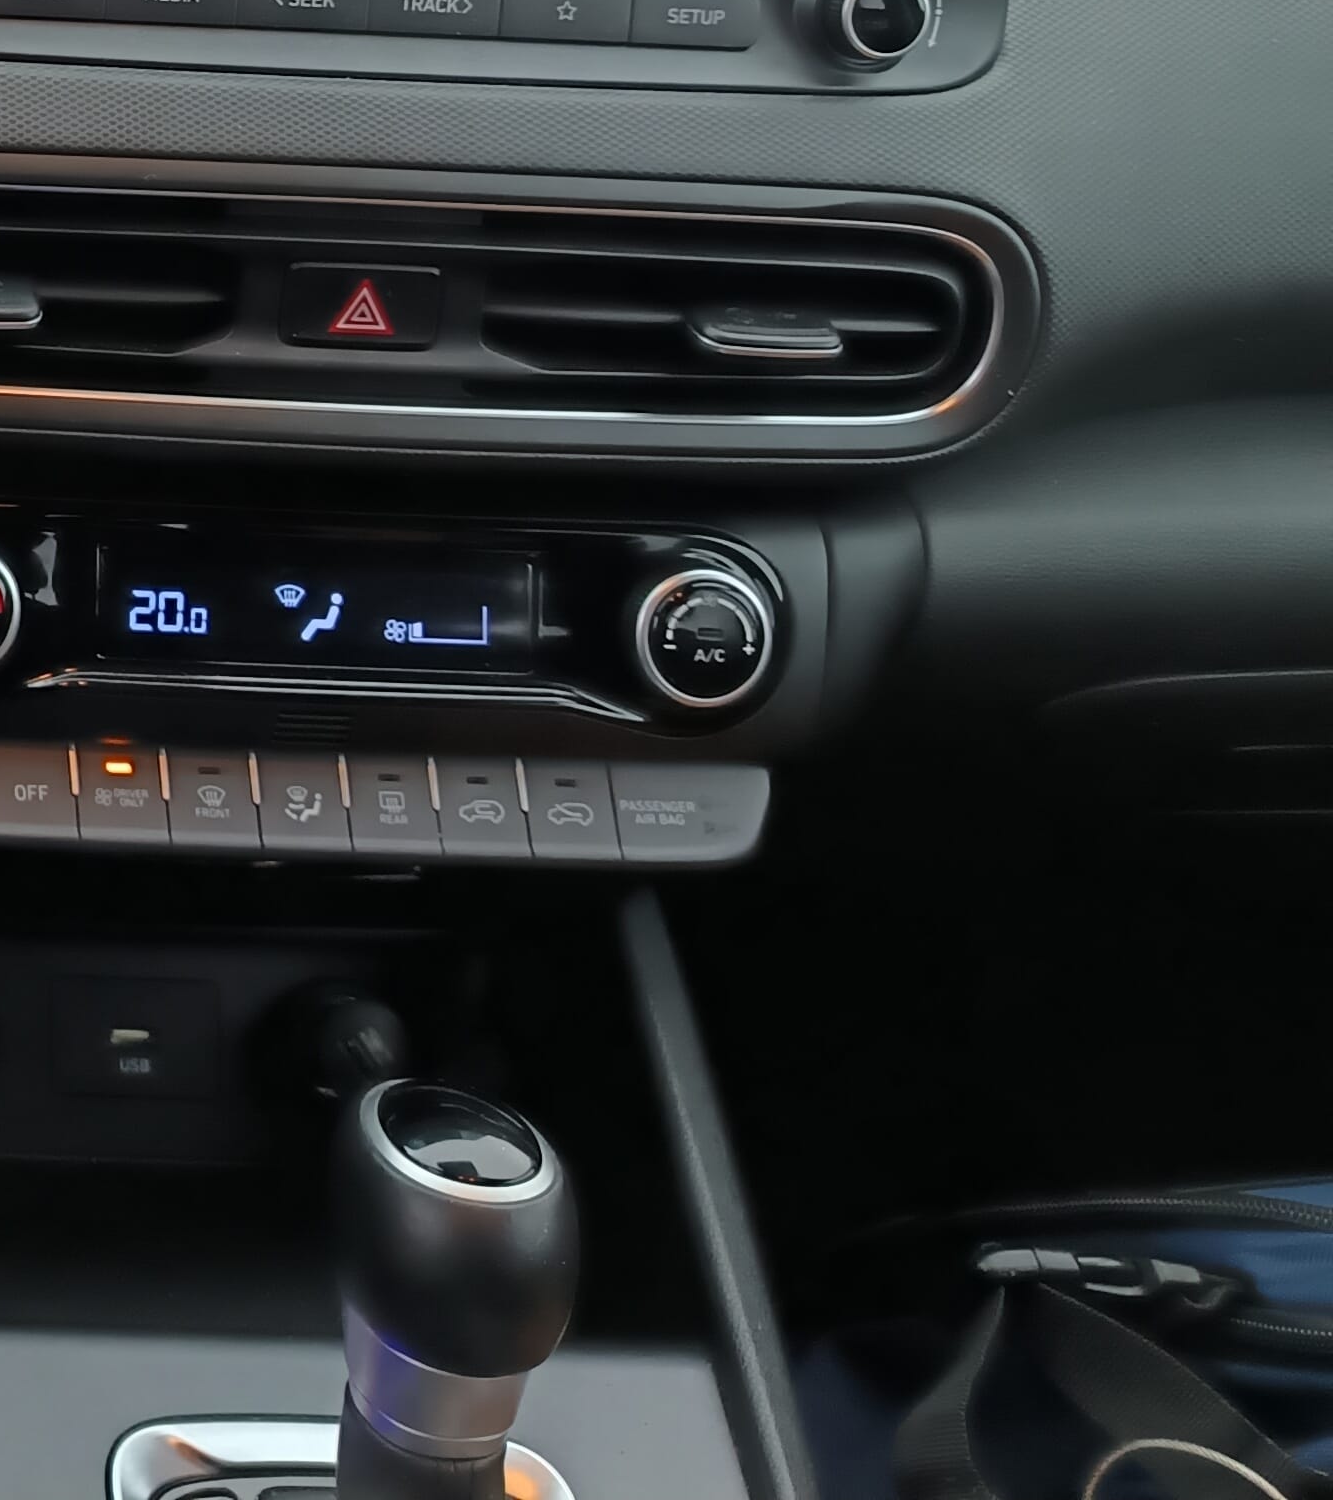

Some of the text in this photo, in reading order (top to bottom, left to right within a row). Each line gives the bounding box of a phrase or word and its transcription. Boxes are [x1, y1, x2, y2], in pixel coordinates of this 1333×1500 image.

[667, 6, 726, 27] SETUP
[129, 589, 209, 635] 20.0
[693, 648, 727, 664] A/C
[14, 784, 49, 802] OFF
[195, 806, 231, 819] FRONT
[619, 799, 696, 813] PASSENGER
[379, 812, 409, 826] REAR
[635, 813, 686, 826] AIR BAG
[119, 1057, 151, 1073] USB
